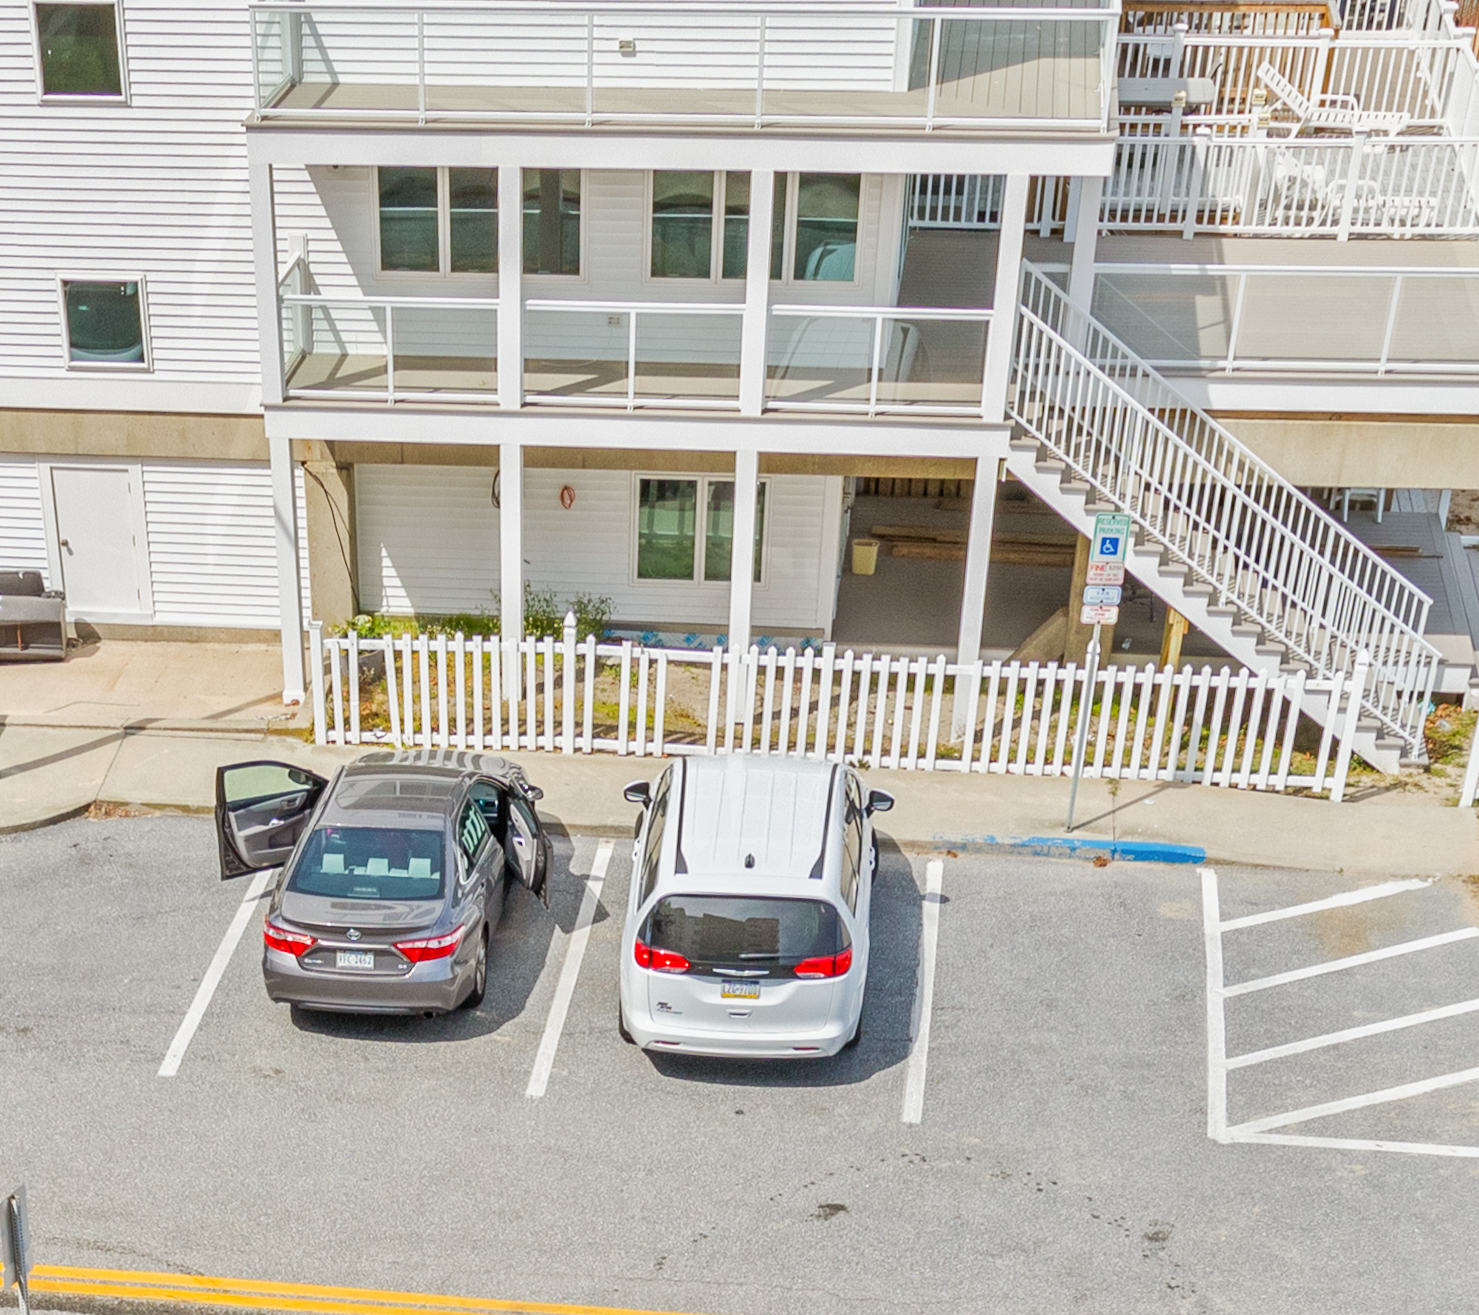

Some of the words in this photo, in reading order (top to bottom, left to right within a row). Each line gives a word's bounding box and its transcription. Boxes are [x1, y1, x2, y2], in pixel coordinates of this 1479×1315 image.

[1097, 517, 1128, 526] RESERVED
[1098, 527, 1125, 535] PARKING
[1090, 564, 1106, 572] FINE
